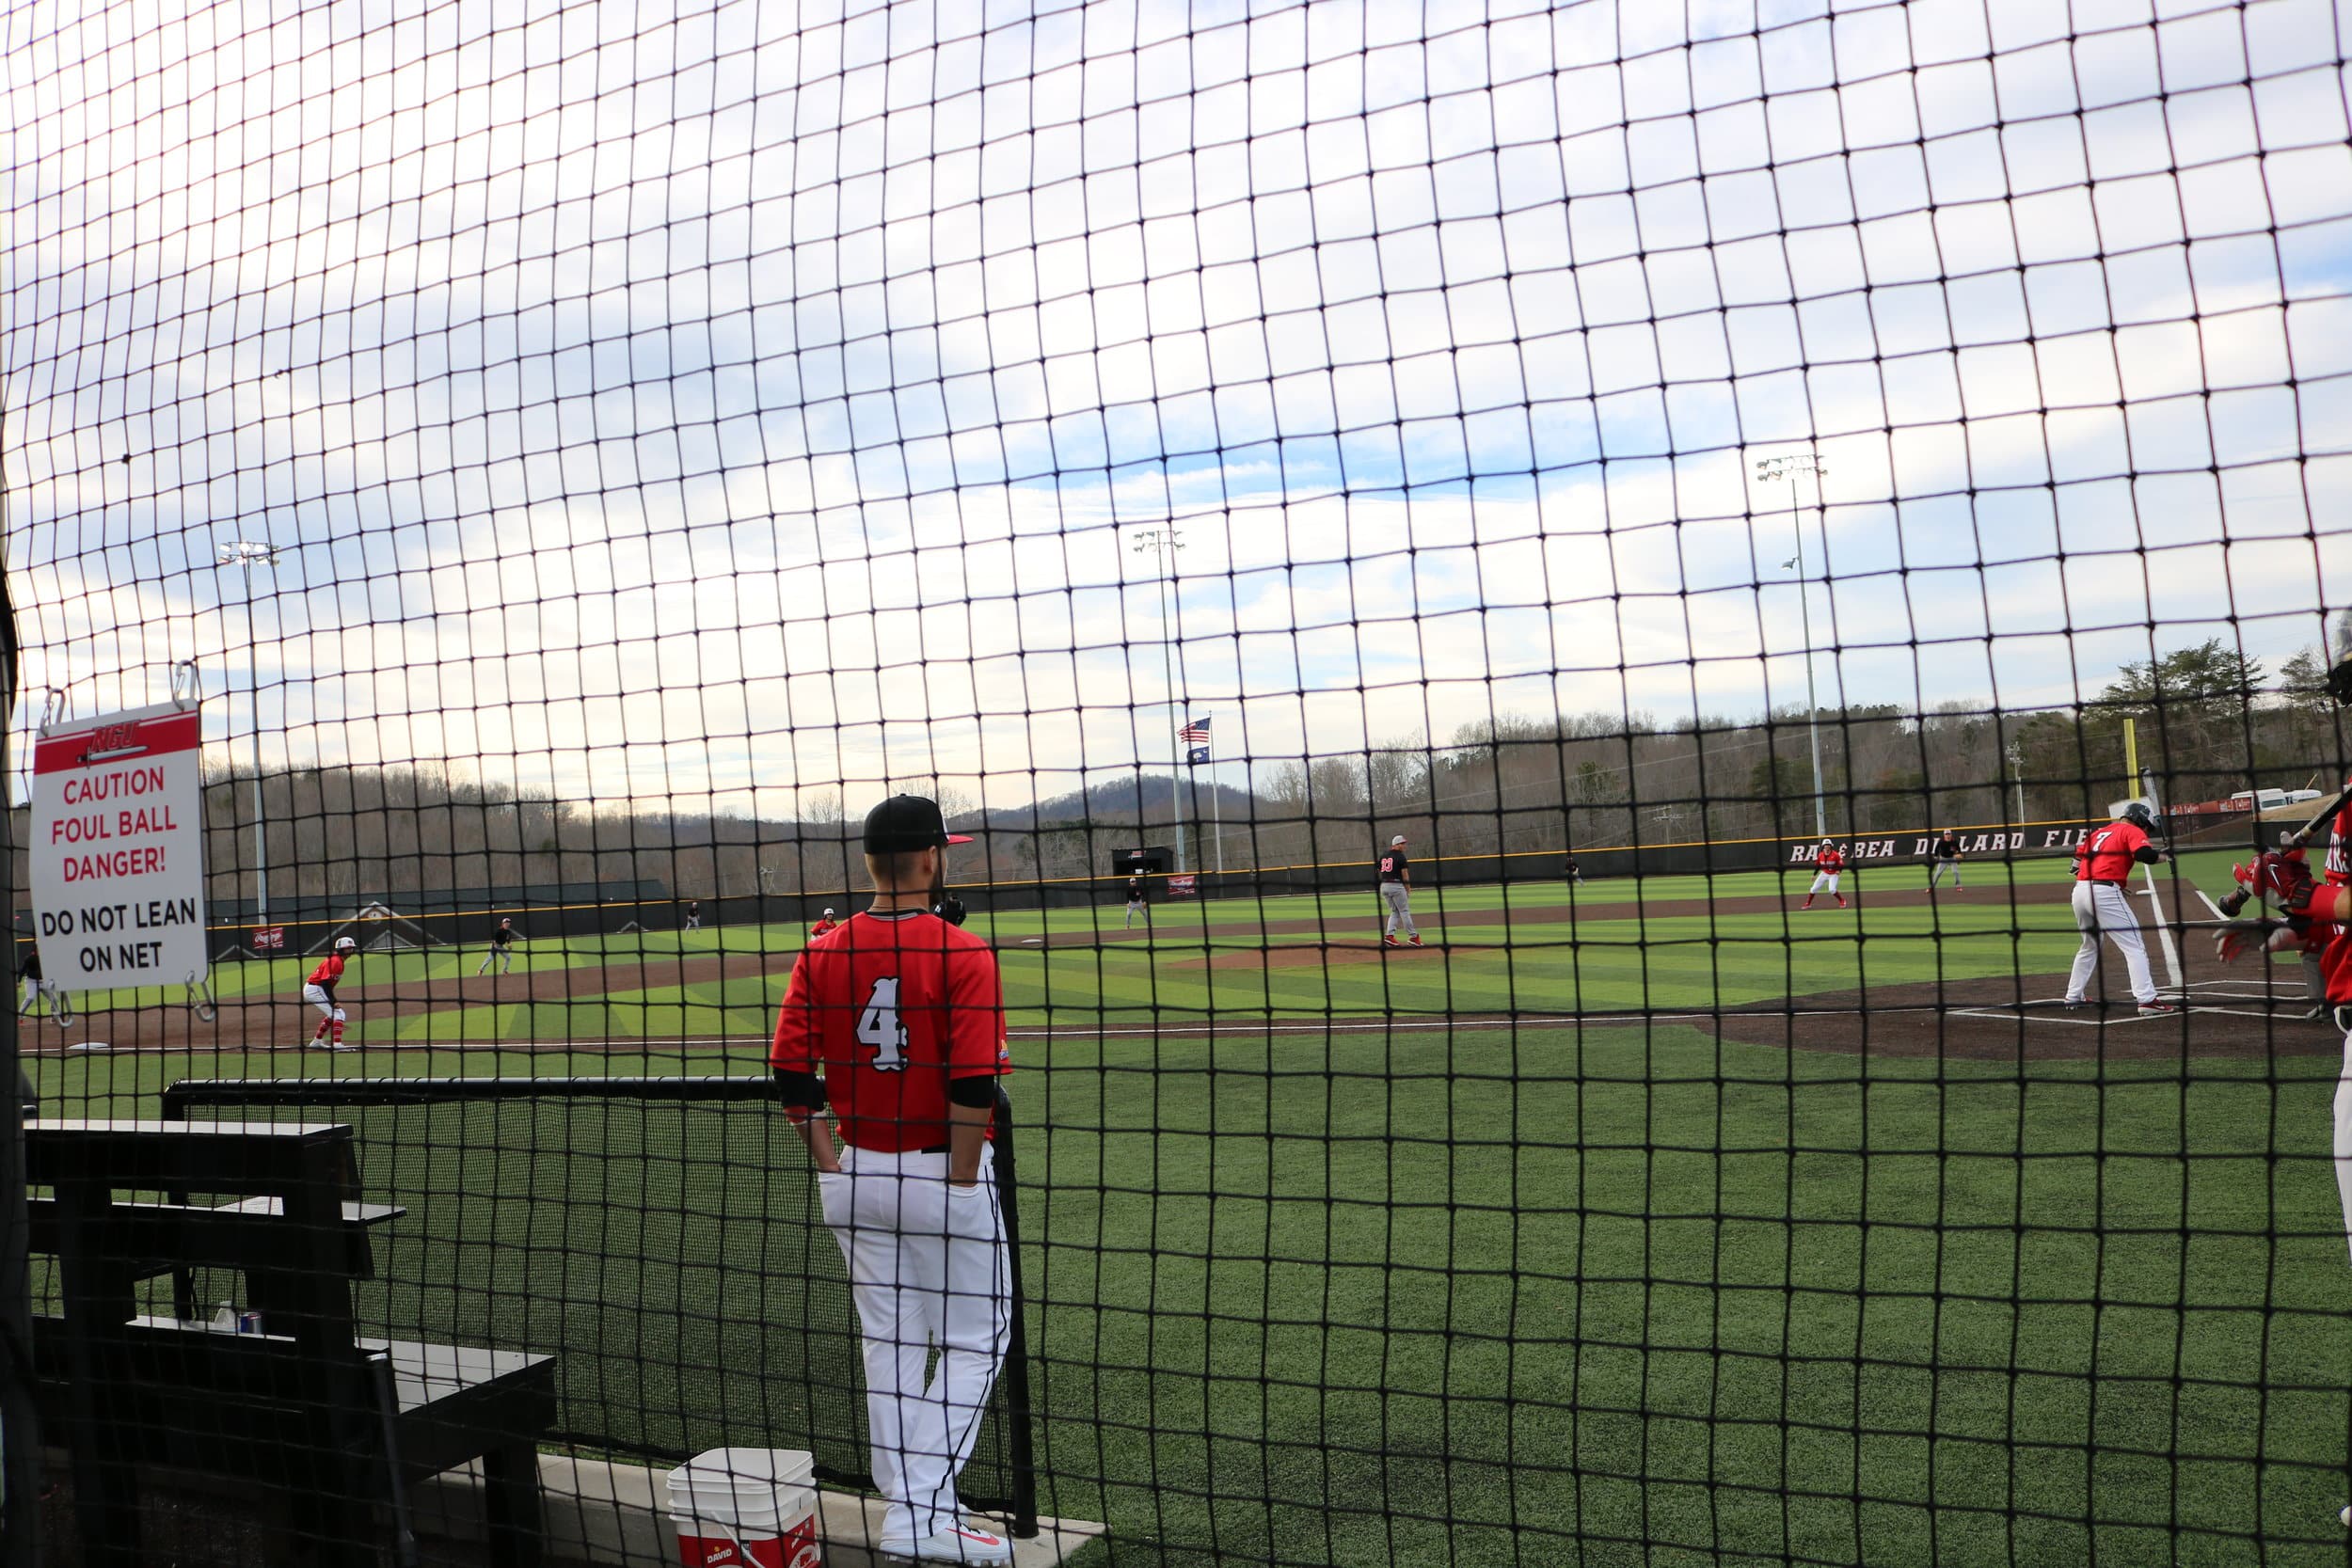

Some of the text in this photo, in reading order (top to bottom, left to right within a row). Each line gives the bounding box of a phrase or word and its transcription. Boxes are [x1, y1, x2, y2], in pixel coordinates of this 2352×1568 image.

[64, 766, 164, 805] CAUTION
[52, 804, 177, 845] FOUL BALL
[63, 846, 166, 882] DANGER!
[1789, 844, 1820, 863] RA
[1851, 839, 1896, 859] BEA
[1914, 832, 2025, 855] DILARD
[41, 897, 196, 936] DO NOT LEAN
[80, 942, 162, 973] ON NET
[855, 976, 909, 1071] 4
[707, 1548, 733, 1564] DAVID
